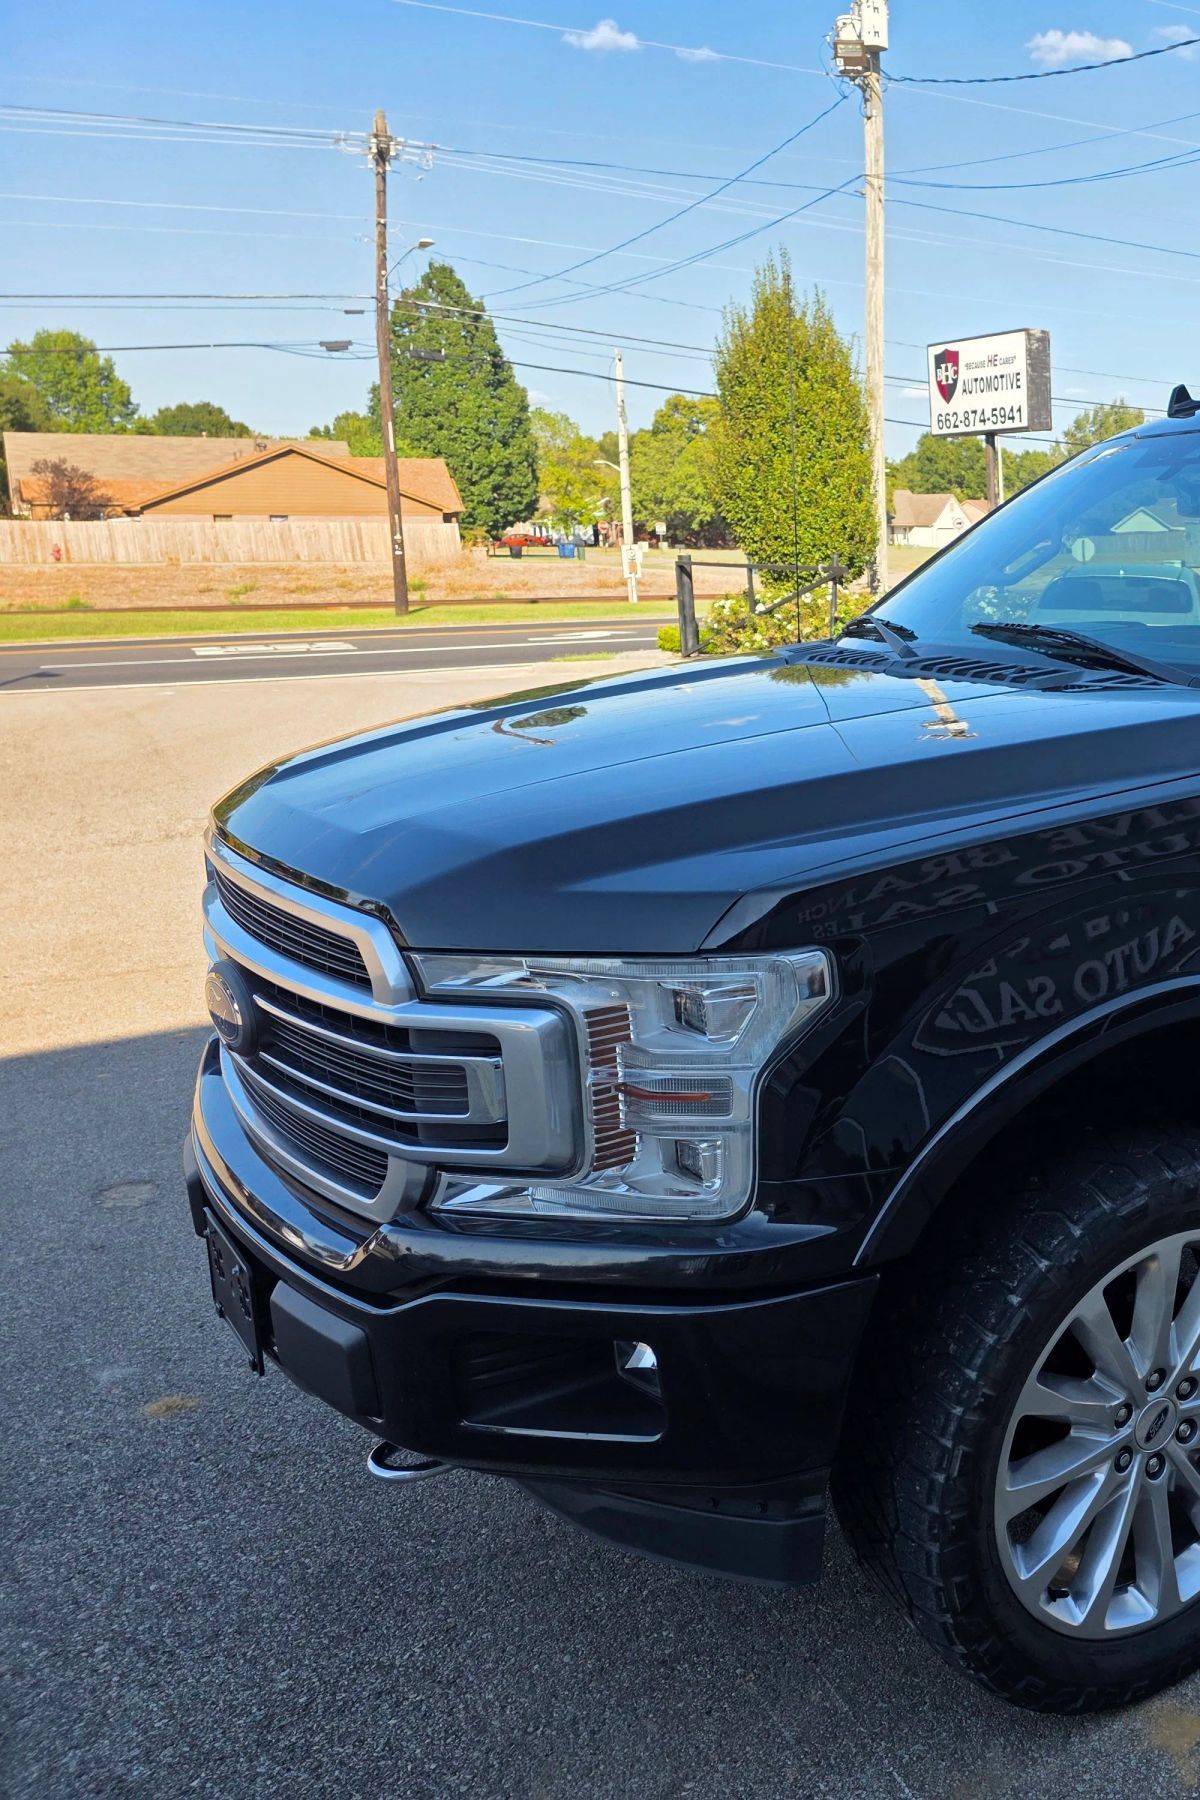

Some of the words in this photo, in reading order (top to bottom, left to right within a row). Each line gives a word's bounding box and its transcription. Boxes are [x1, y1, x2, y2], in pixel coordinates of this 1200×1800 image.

[987, 354, 998, 367] HE
[962, 372, 1021, 396] AUTOMOTIVE
[937, 405, 1022, 430] 662-874-5941
